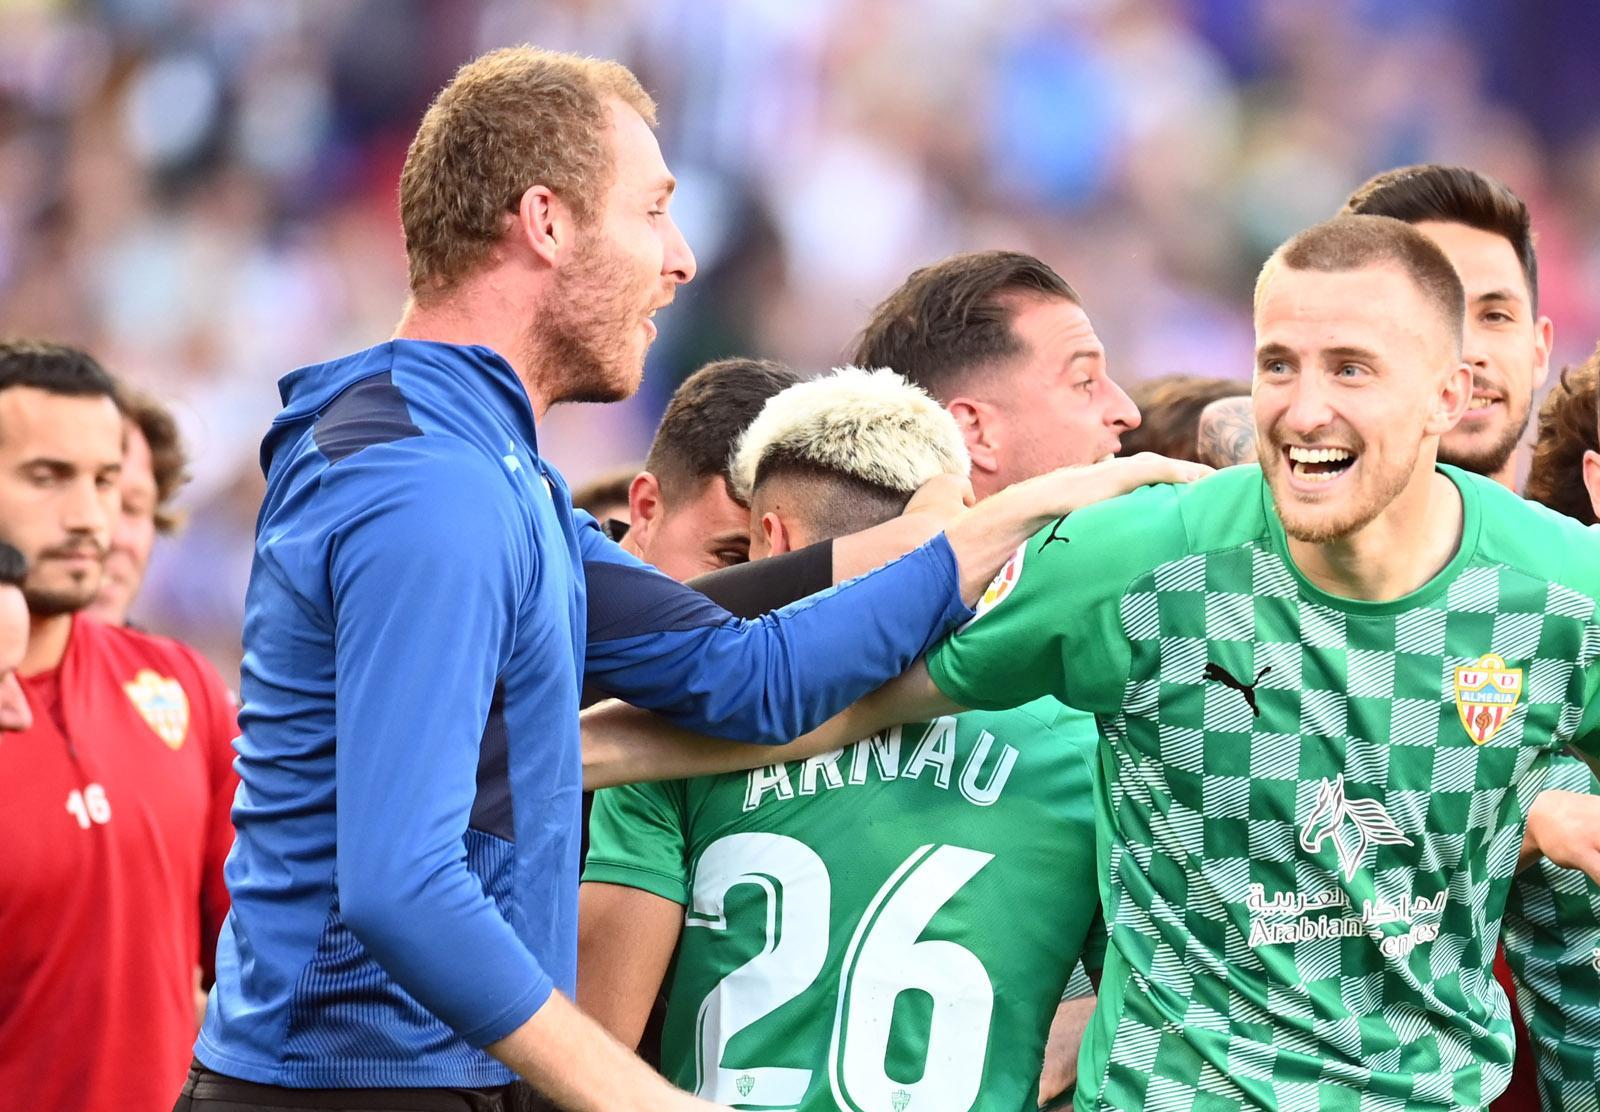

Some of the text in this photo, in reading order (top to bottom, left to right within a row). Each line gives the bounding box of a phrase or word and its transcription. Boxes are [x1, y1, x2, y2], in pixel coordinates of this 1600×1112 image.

[1461, 690, 1515, 703] ALMERIA
[742, 715, 1020, 807] ARNAU
[65, 783, 112, 830] 16
[1247, 914, 1363, 948] Arabian
